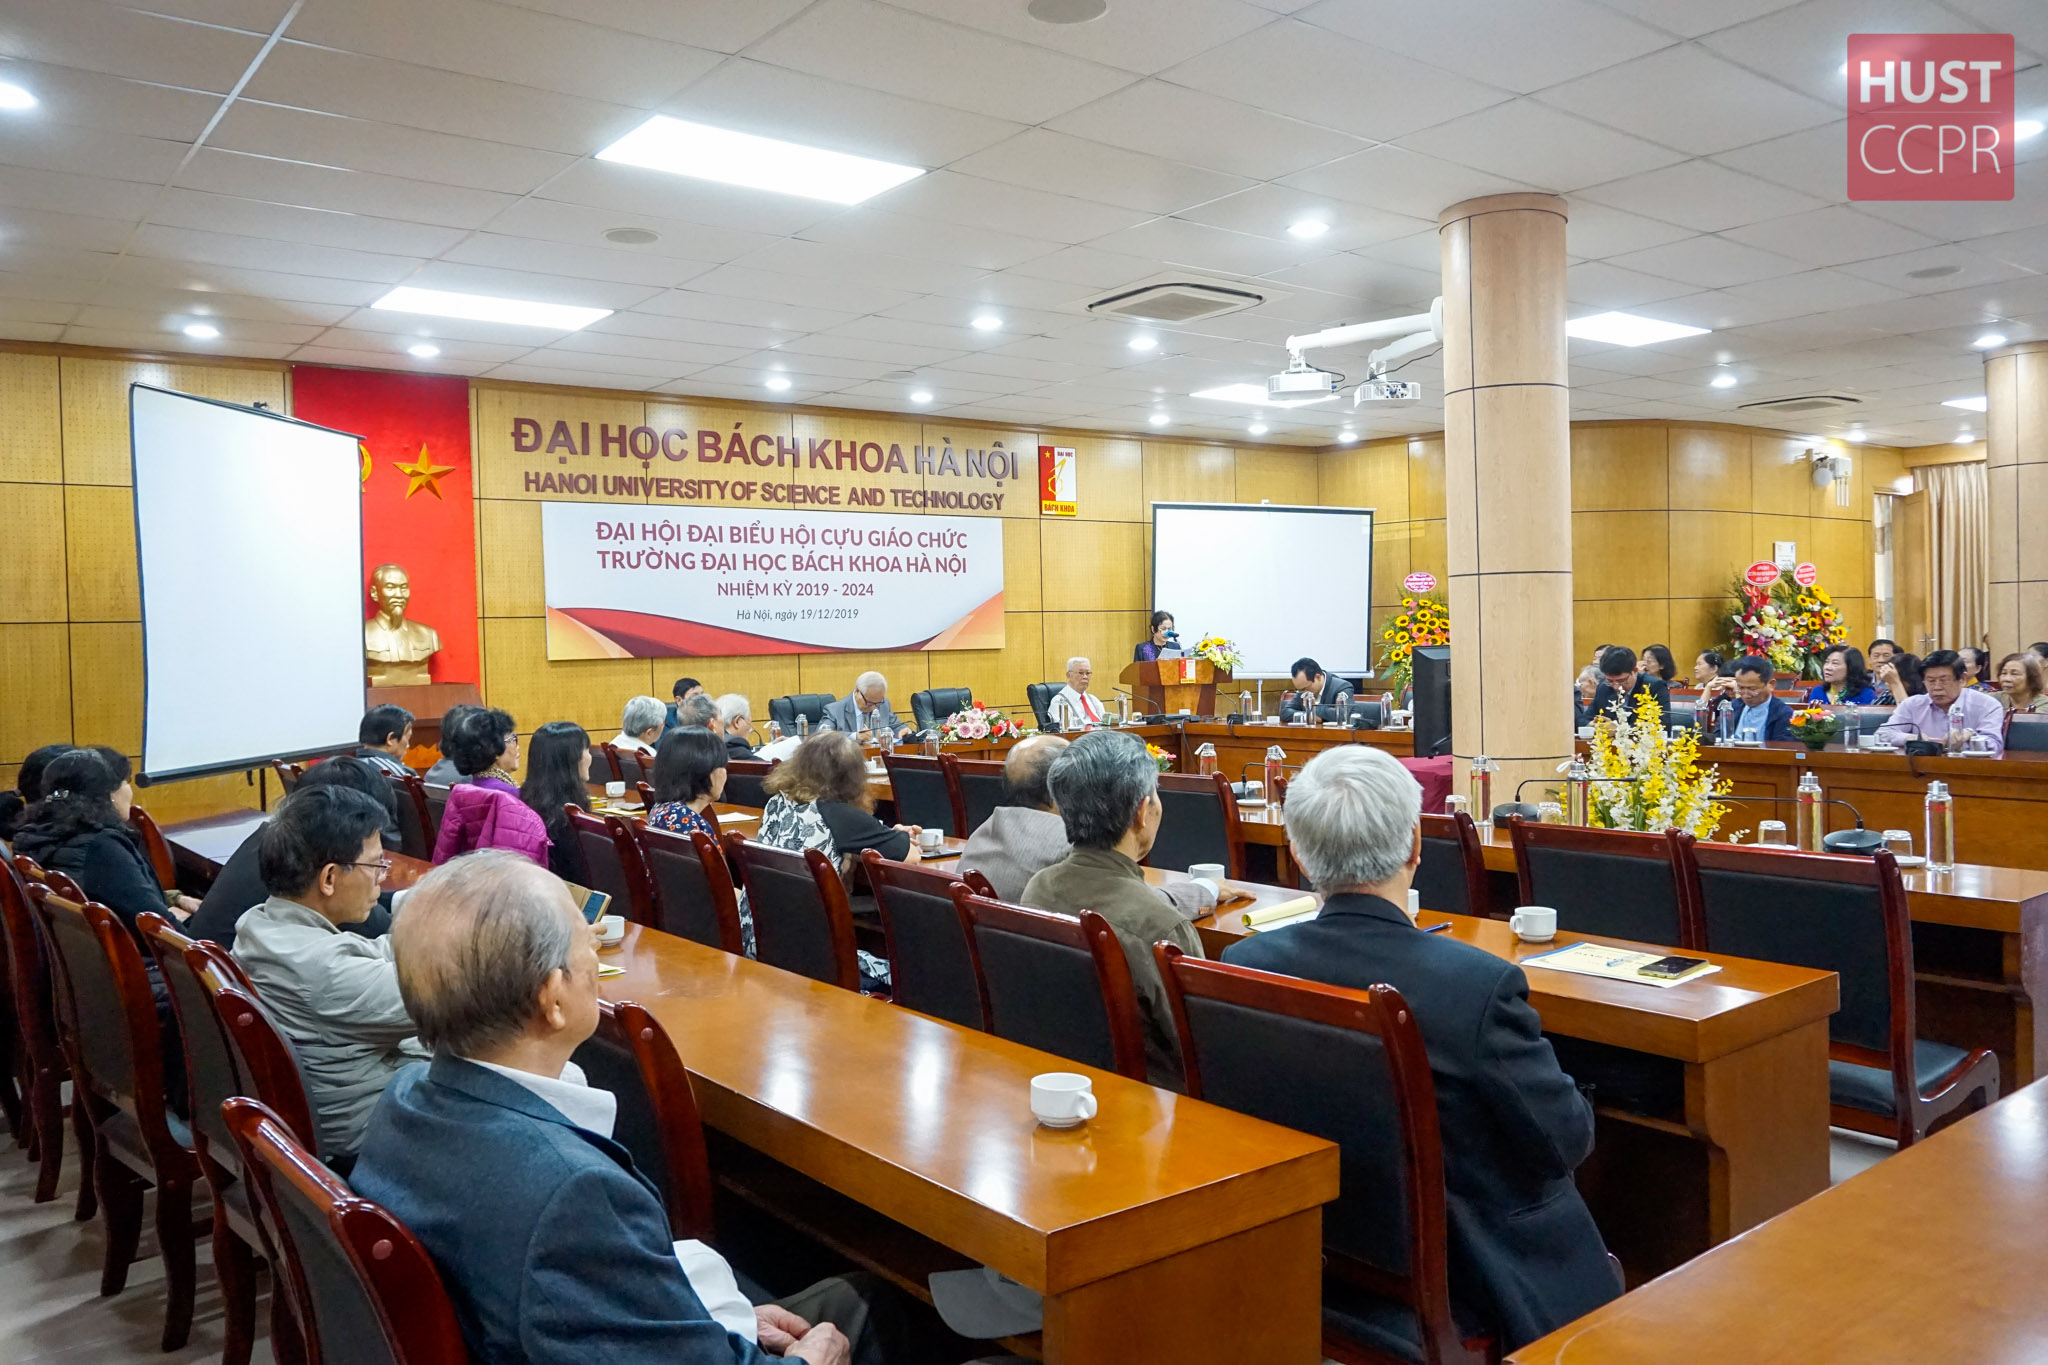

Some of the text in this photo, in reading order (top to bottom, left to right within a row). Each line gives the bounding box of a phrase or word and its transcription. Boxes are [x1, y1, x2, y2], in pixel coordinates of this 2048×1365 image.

[511, 417, 1018, 487] ĐẠI HỌC BÁCH KHOA HÀ NỘI
[524, 471, 1005, 511] HANOI UNIVERSITY OF SCIENCE AND TECHNOLOGY
[595, 519, 968, 550] ĐẠI HỘI ĐẠI BIỂU HỘI CỰU GIÁO CHỨC
[597, 547, 967, 577] TRƯỜNG ĐẠI HỌC BÁCH KHOA HÀ NỘI
[717, 580, 769, 599] NHIỆM
[773, 580, 793, 596] KỲ
[796, 583, 829, 596] 2019
[842, 583, 874, 596] 2024
[737, 608, 859, 622] Hà Nội, ngày 19/12/2019
